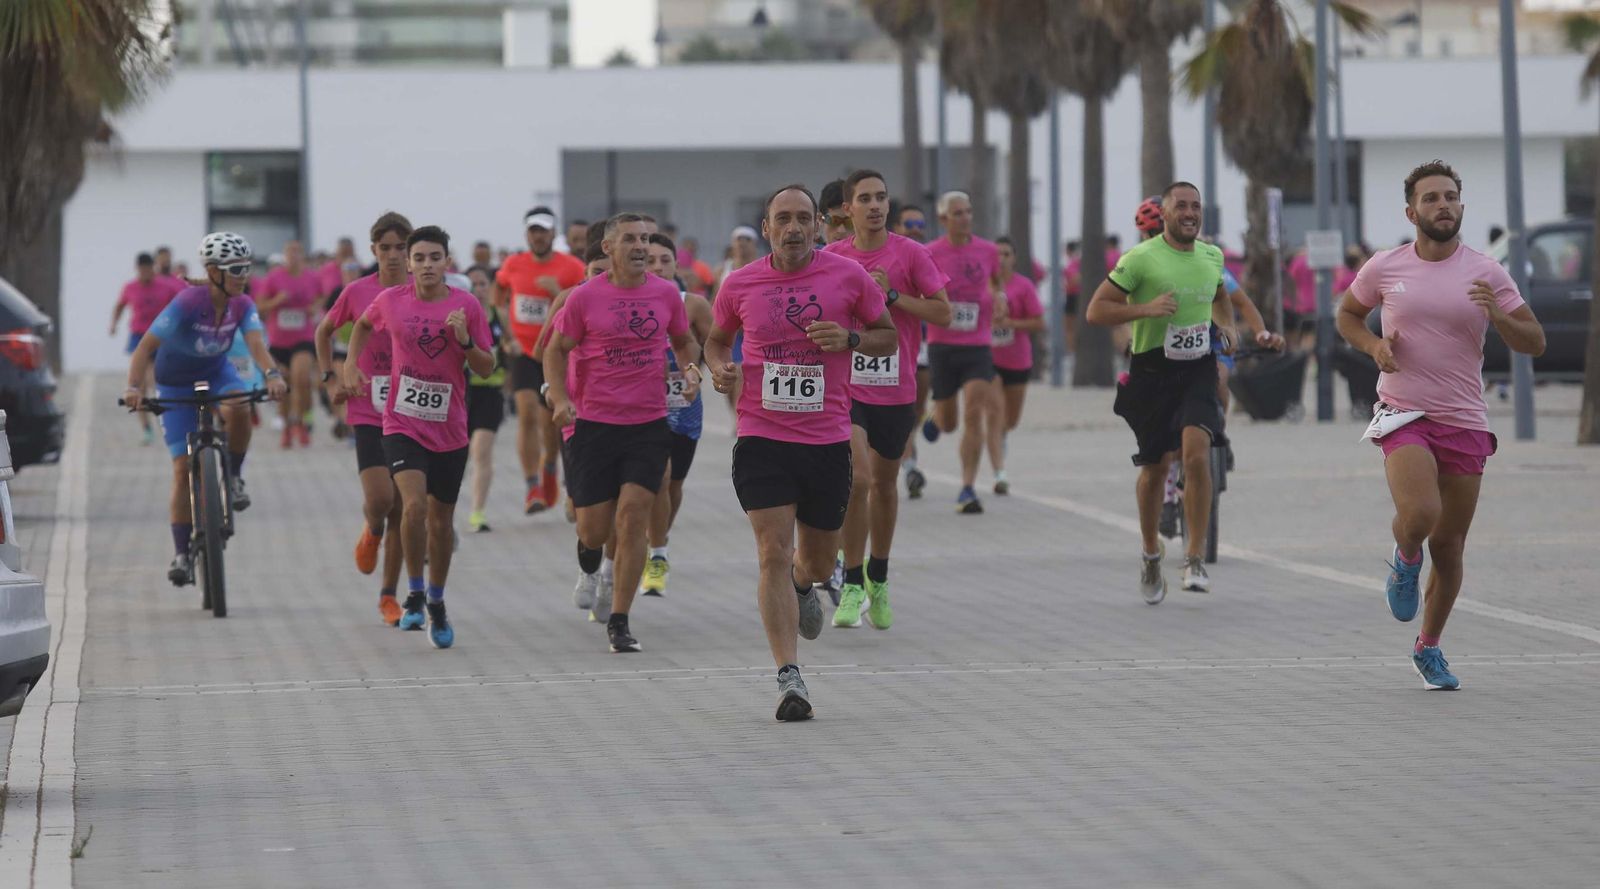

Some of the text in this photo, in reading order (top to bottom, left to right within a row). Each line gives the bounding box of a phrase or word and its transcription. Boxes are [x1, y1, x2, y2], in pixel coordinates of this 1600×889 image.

[1171, 333, 1204, 349] 285
[854, 355, 891, 373] 841
[769, 377, 816, 397] 116
[404, 388, 443, 409] 289
